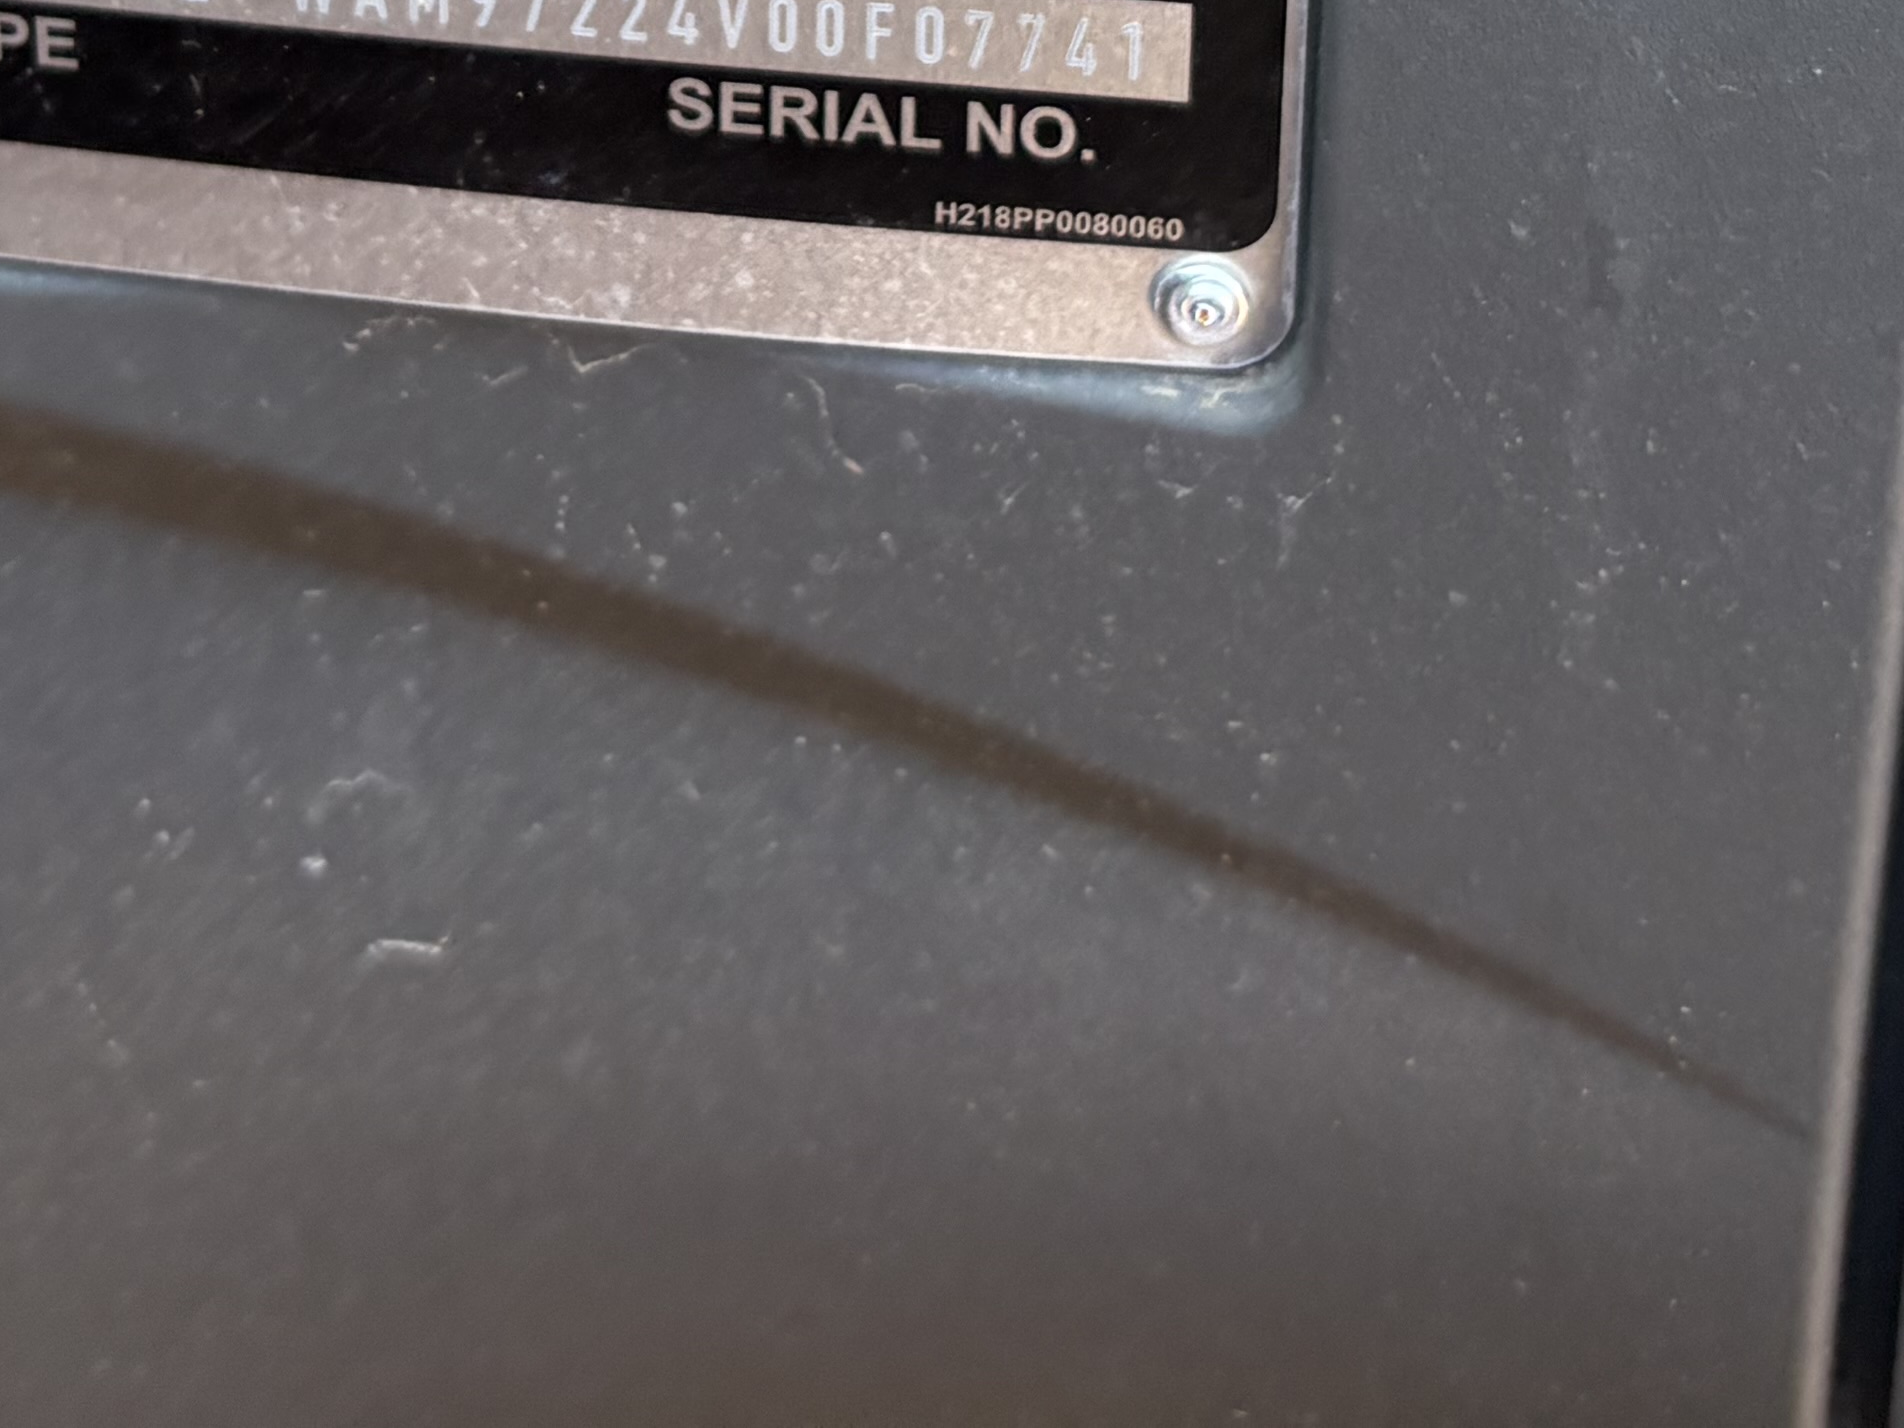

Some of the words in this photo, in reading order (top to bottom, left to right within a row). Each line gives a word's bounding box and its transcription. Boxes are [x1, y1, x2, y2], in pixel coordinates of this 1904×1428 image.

[668, 77, 942, 150] SERIAL
[966, 101, 1097, 161] NO.
[934, 200, 1184, 242] H218PP0080060
